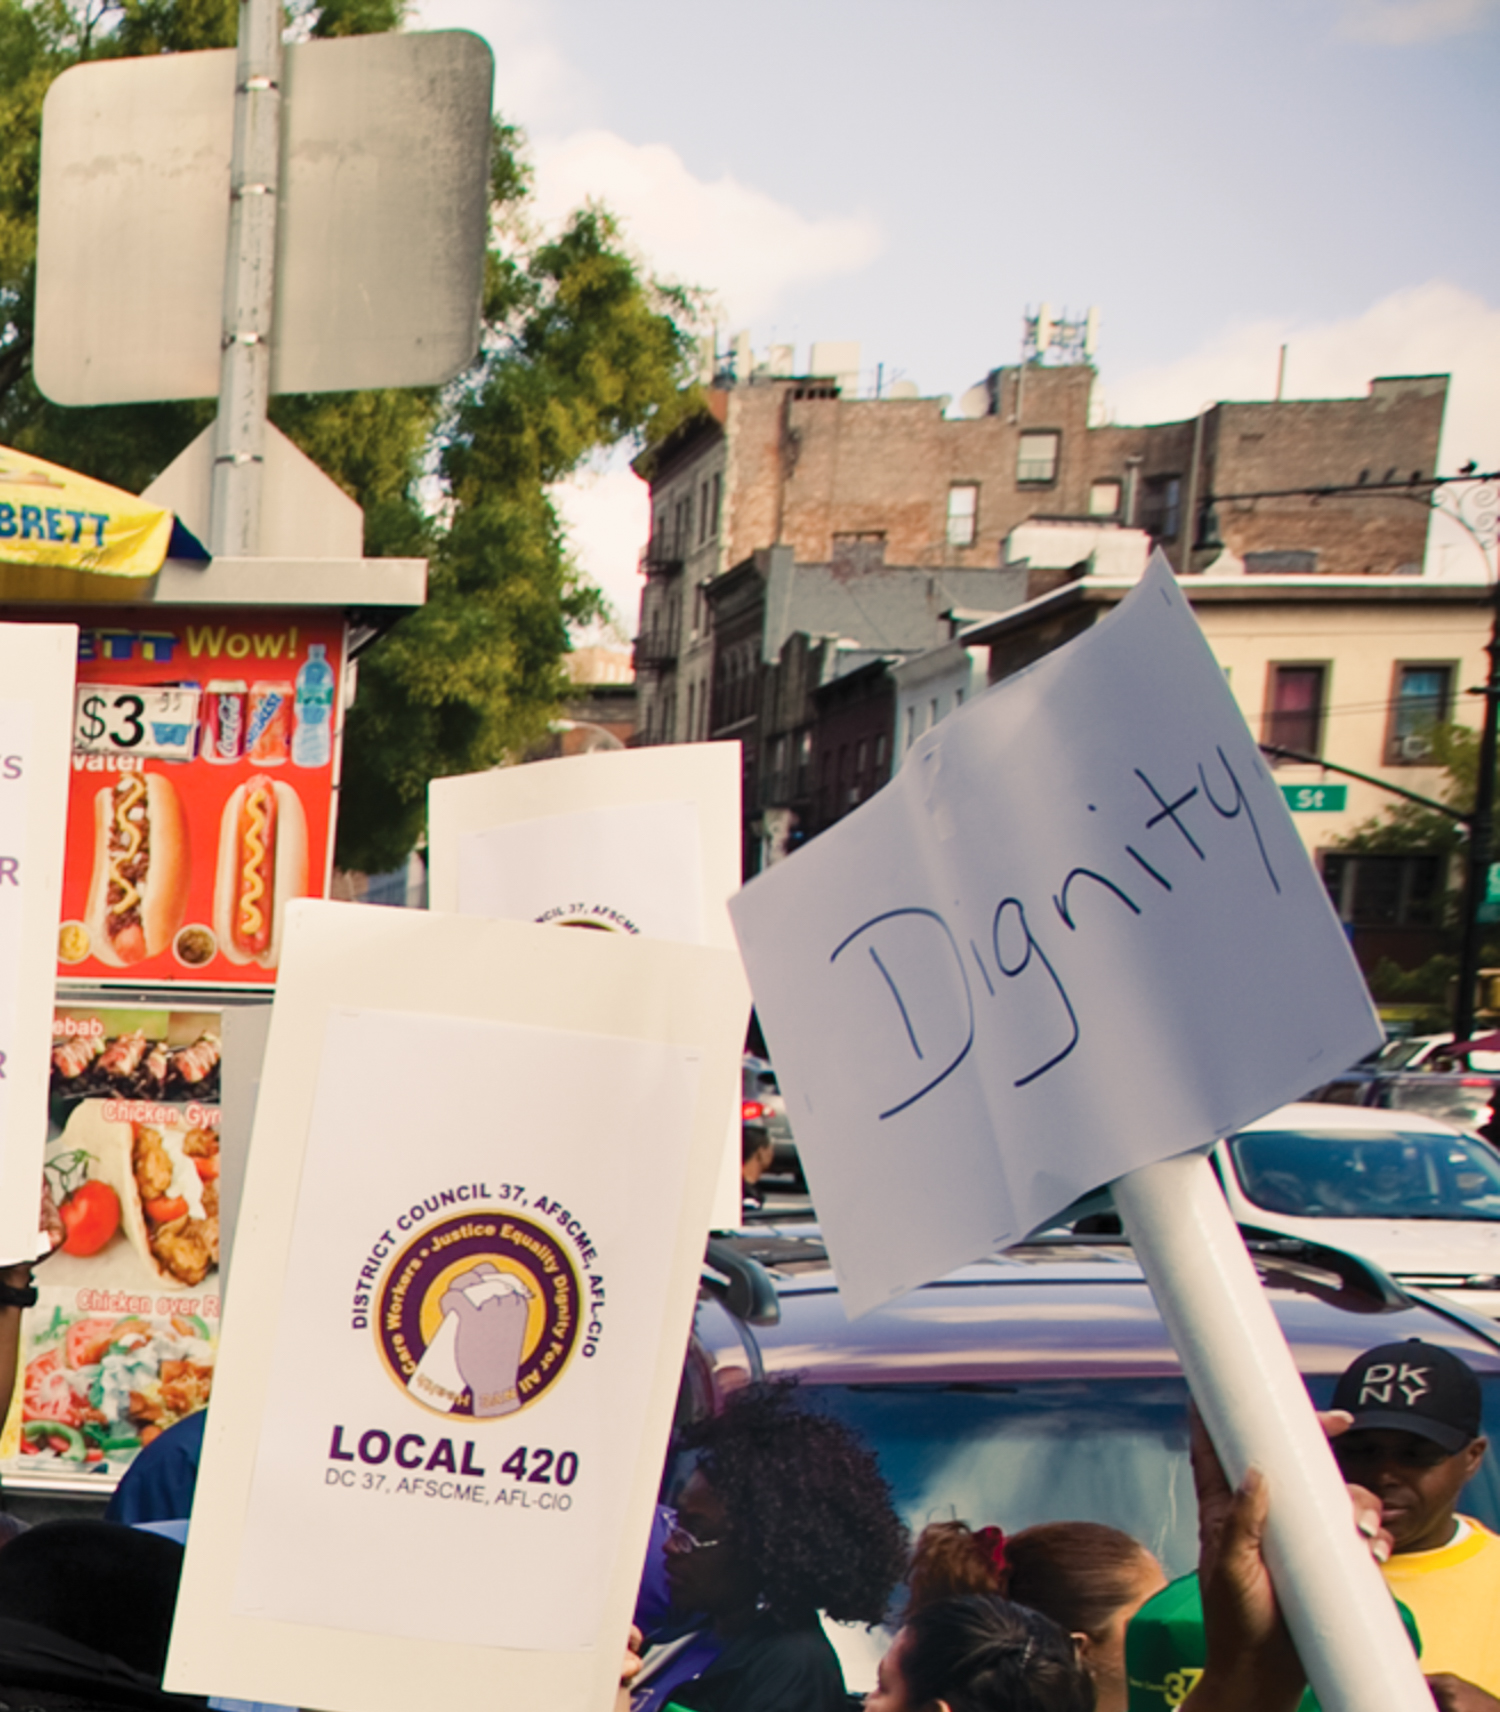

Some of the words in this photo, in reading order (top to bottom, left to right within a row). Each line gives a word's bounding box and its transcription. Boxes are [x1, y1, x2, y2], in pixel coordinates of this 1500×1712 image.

[186, 625, 298, 660] Wow!
[1297, 789, 1325, 809] St
[828, 744, 1281, 1120] Dignity
[103, 1102, 179, 1124] Chicken
[431, 1223, 496, 1253] Justice
[499, 1224, 559, 1274] Equality
[352, 1230, 397, 1329] DISTRICT
[396, 1183, 491, 1231] COUNCIL
[498, 1184, 528, 1206] 37,
[533, 1196, 598, 1270] AFSCME,
[581, 1273, 605, 1358] AFL-CIO
[76, 1287, 151, 1314] Chicken
[155, 1296, 199, 1316] over
[386, 1256, 423, 1331] Workers
[553, 1274, 570, 1339] Dignity
[540, 1341, 564, 1371] For
[518, 1369, 541, 1394] All
[1363, 1363, 1432, 1387] DK
[1359, 1383, 1431, 1406] NY
[327, 1424, 487, 1478] LOCAL
[500, 1445, 580, 1487] 420
[324, 1468, 356, 1490] DC
[361, 1472, 391, 1496] 37,
[396, 1473, 489, 1507] AFSCME,
[494, 1488, 573, 1513] AFL-CIO
